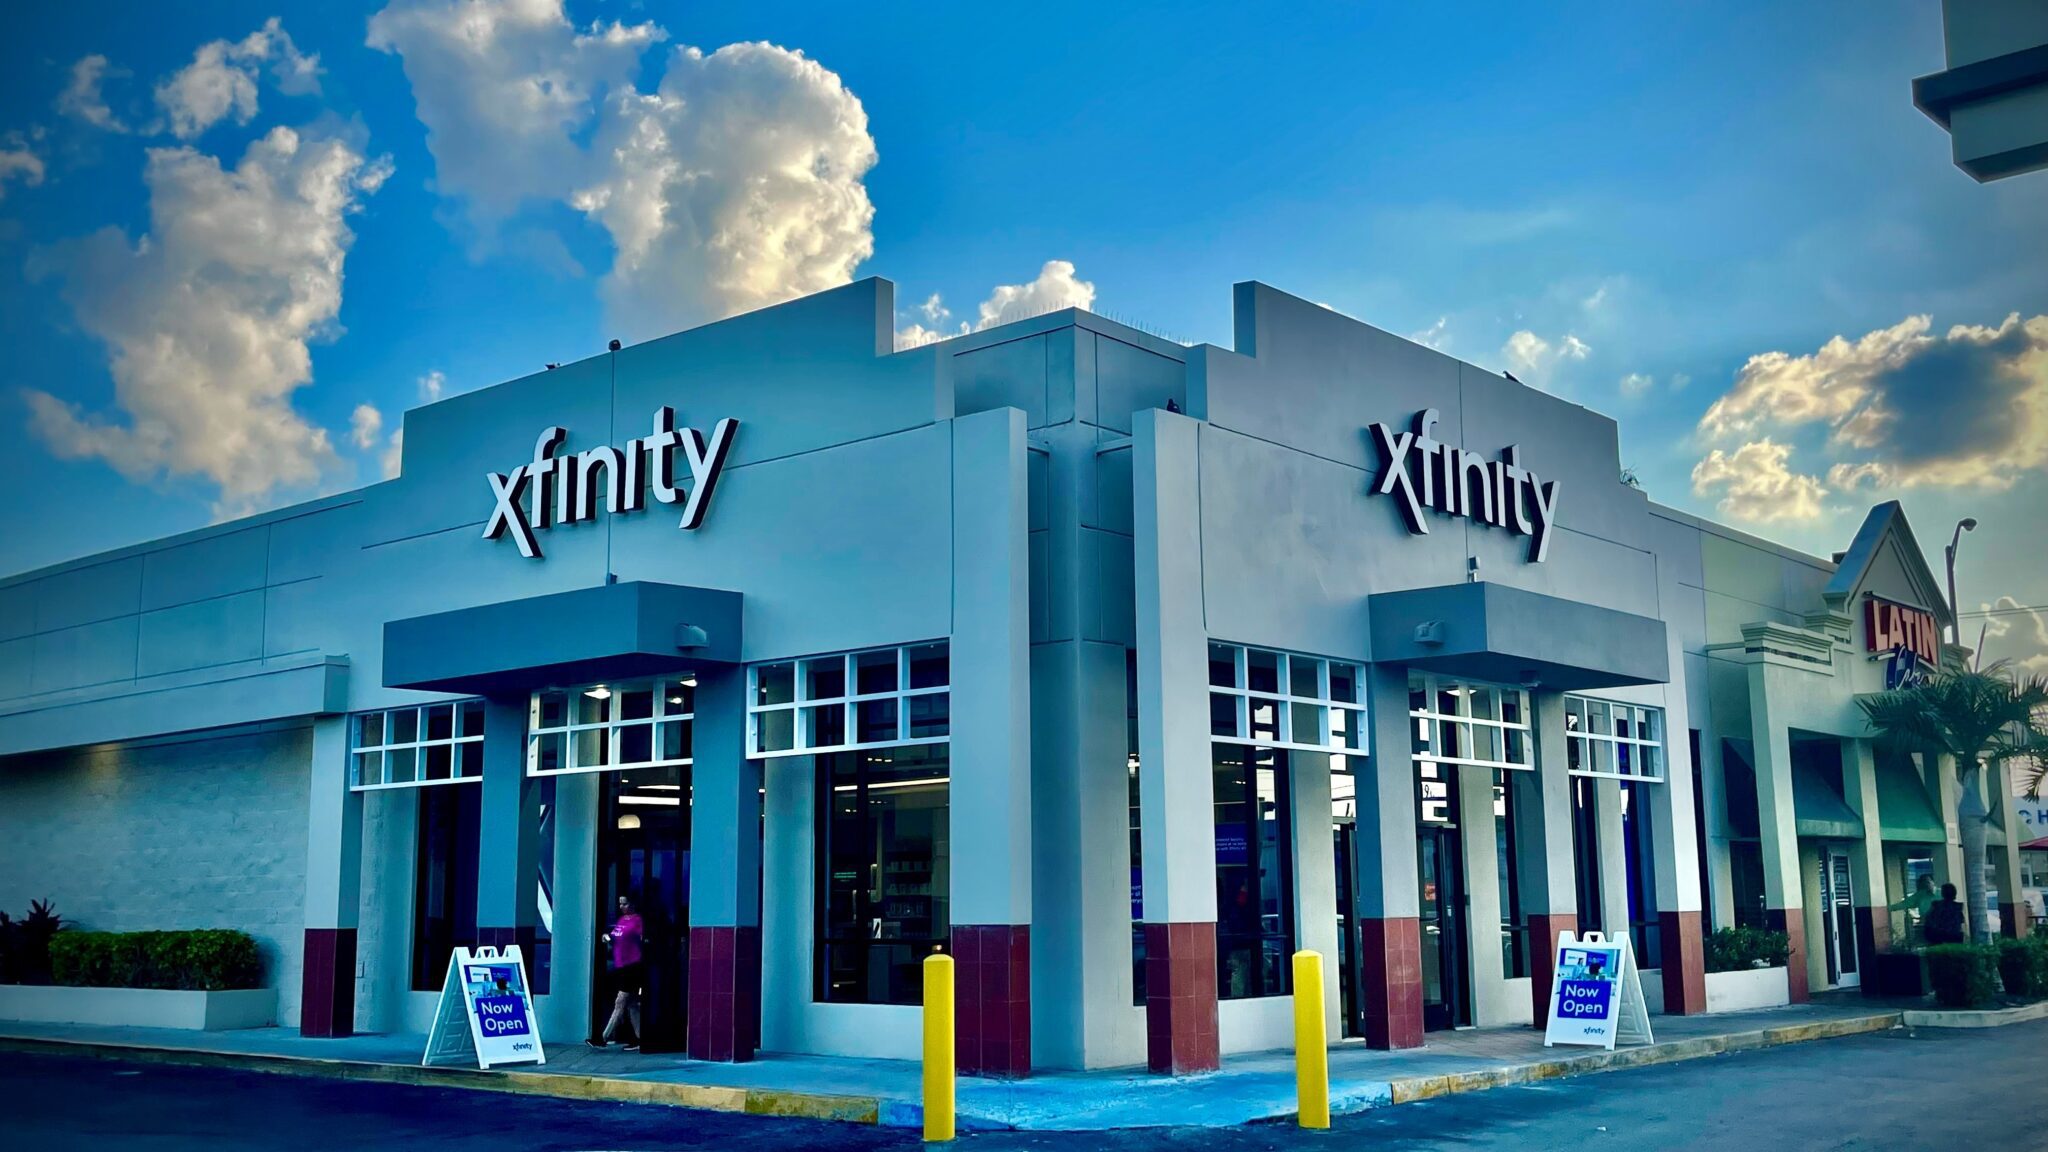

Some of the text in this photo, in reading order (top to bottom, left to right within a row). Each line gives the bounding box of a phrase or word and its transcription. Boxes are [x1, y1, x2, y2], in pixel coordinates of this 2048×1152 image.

[482, 406, 739, 558] xfinity
[1369, 408, 1561, 563] xfinity
[1872, 600, 1938, 665] LATIN
[1565, 984, 1599, 998] Now
[481, 1002, 513, 1016] Now
[1563, 1000, 1603, 1016] Open
[485, 1018, 524, 1034] Open
